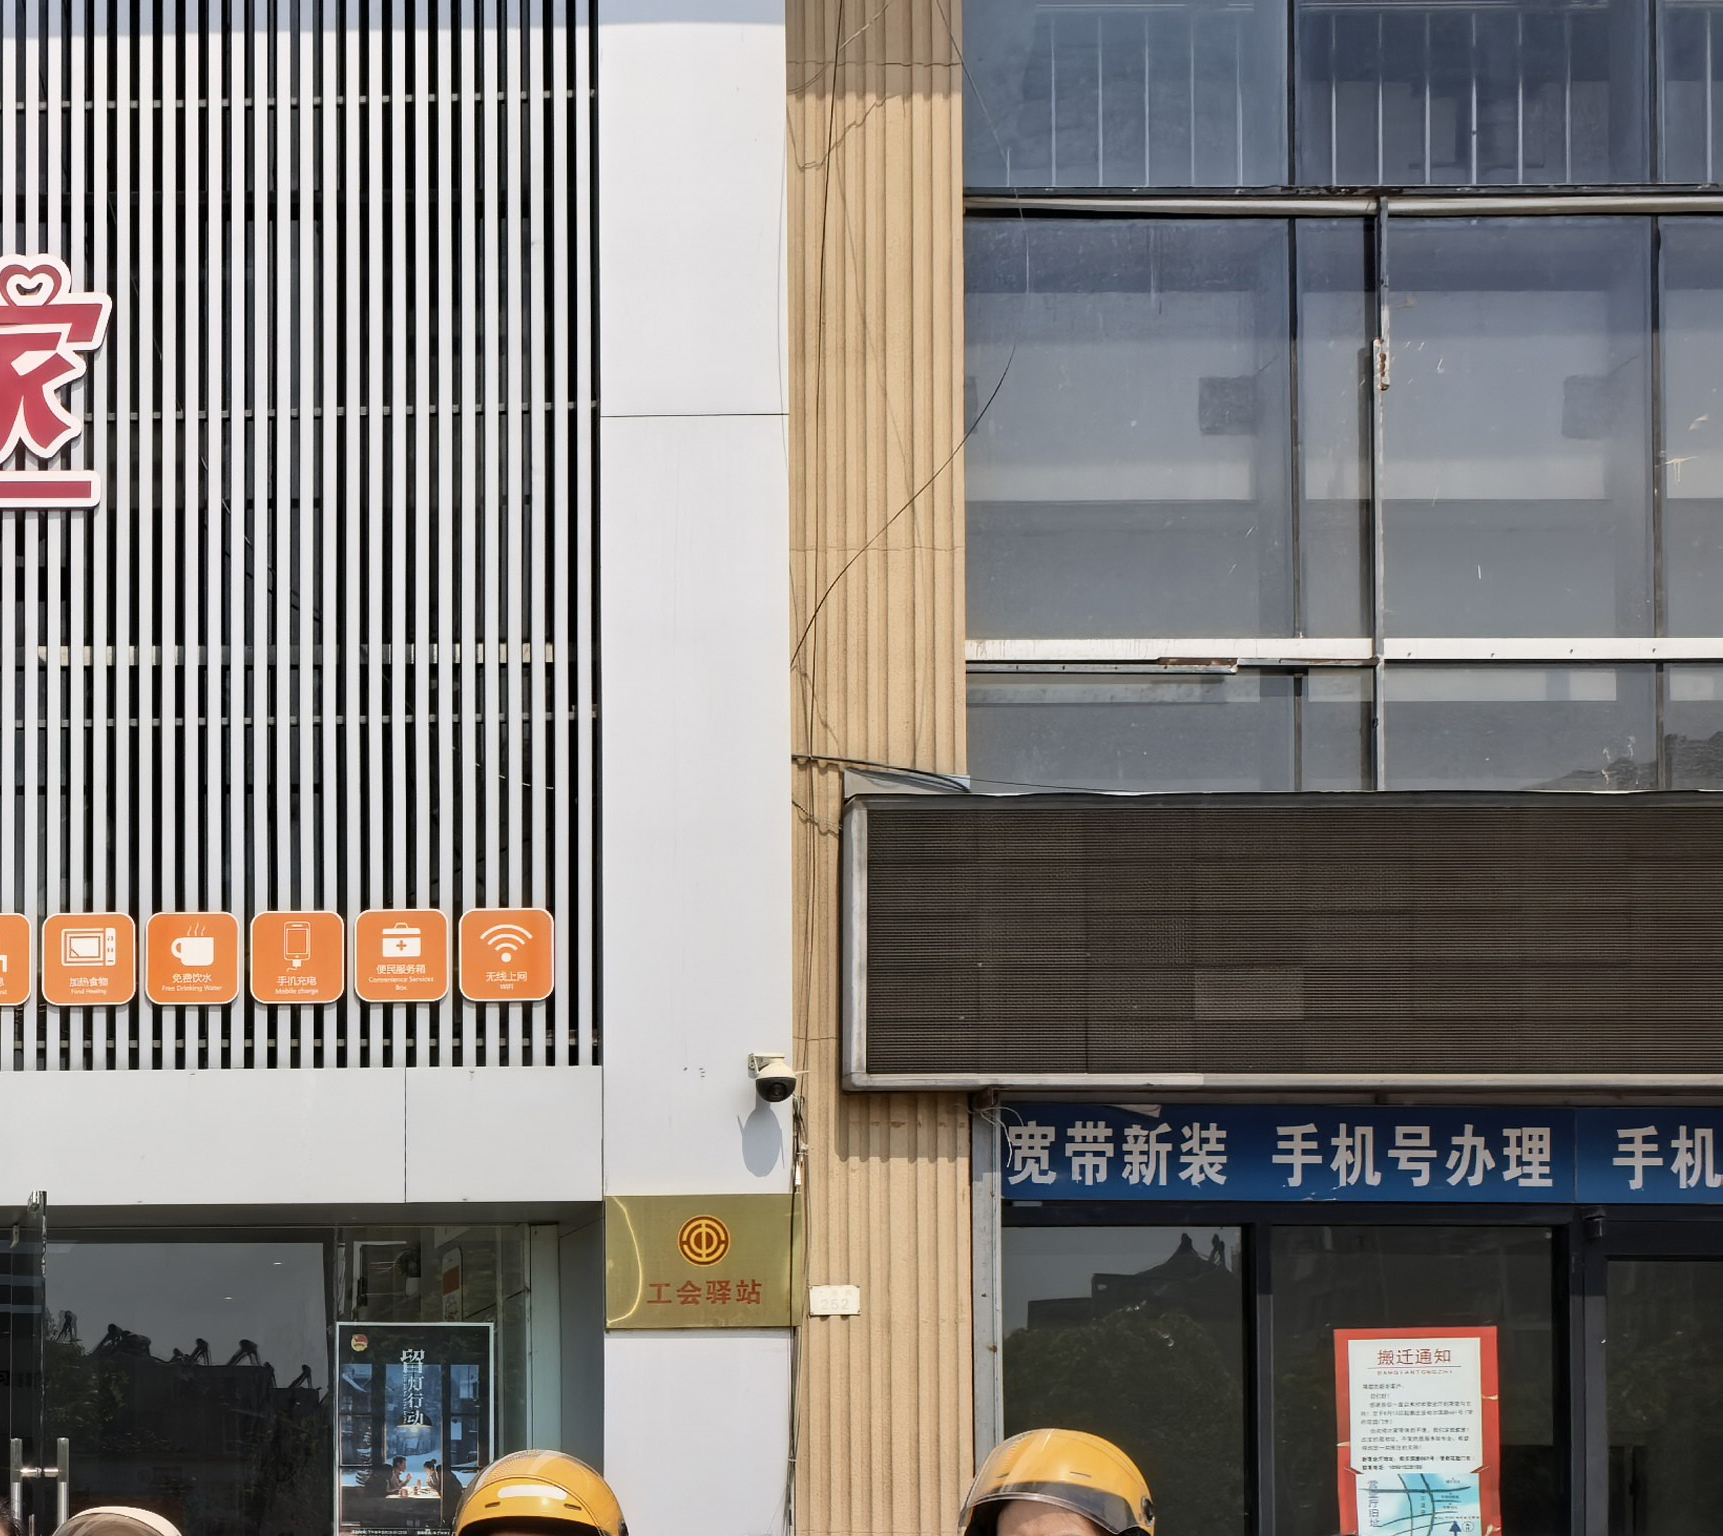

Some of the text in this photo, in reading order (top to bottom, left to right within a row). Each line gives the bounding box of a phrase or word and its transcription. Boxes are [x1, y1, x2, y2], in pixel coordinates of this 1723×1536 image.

[376, 964, 426, 974] 便民服务箱
[172, 973, 211, 983] 免费饮水
[277, 976, 317, 986] 手机充电
[486, 972, 527, 982] 无线上网
[1008, 1122, 1723, 1190] 宽带新装 手机号办理 手机
[647, 1279, 763, 1305] 工会驿站
[1378, 1349, 1451, 1365] 搬迁通知
